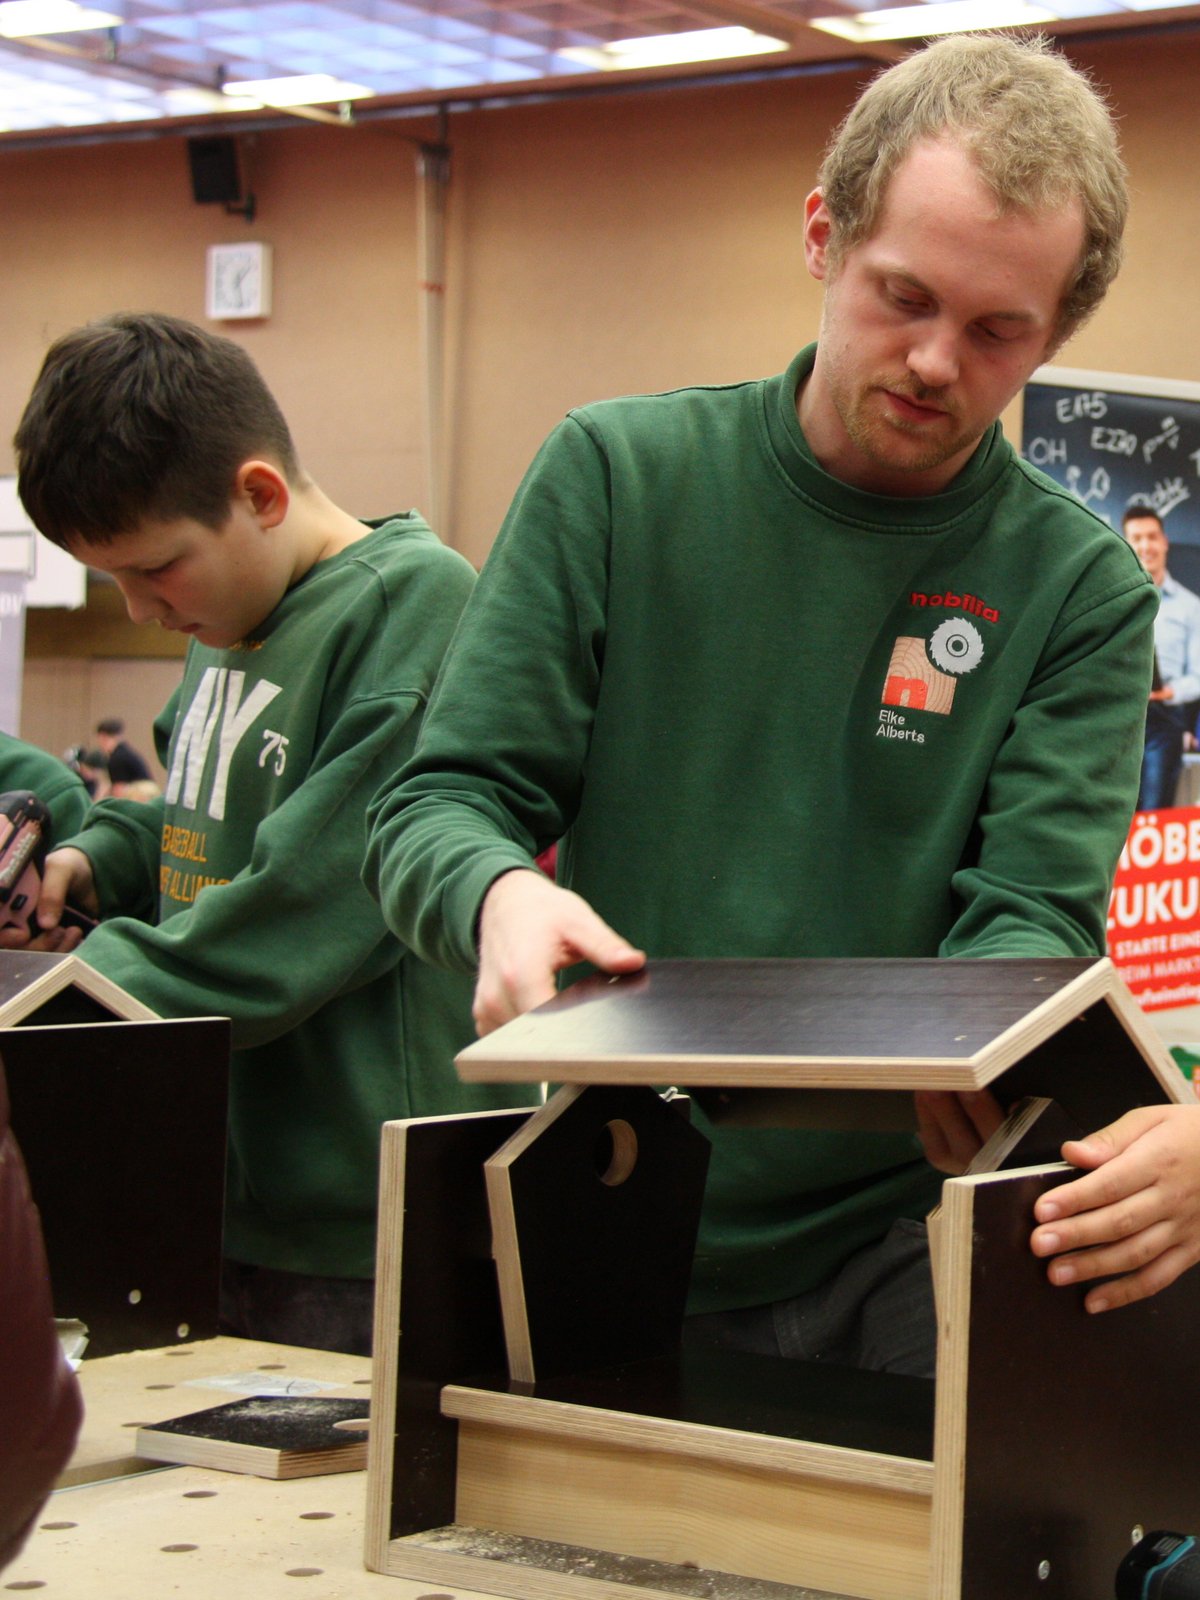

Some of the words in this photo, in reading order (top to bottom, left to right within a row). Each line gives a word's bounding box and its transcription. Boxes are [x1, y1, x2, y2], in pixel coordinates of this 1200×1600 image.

[910, 591, 1000, 624] nobilia
[879, 709, 906, 725] Elke
[165, 667, 283, 822] NY
[876, 724, 925, 743] Alberts
[259, 728, 290, 777] 75
[1115, 935, 1168, 959] STARTE
